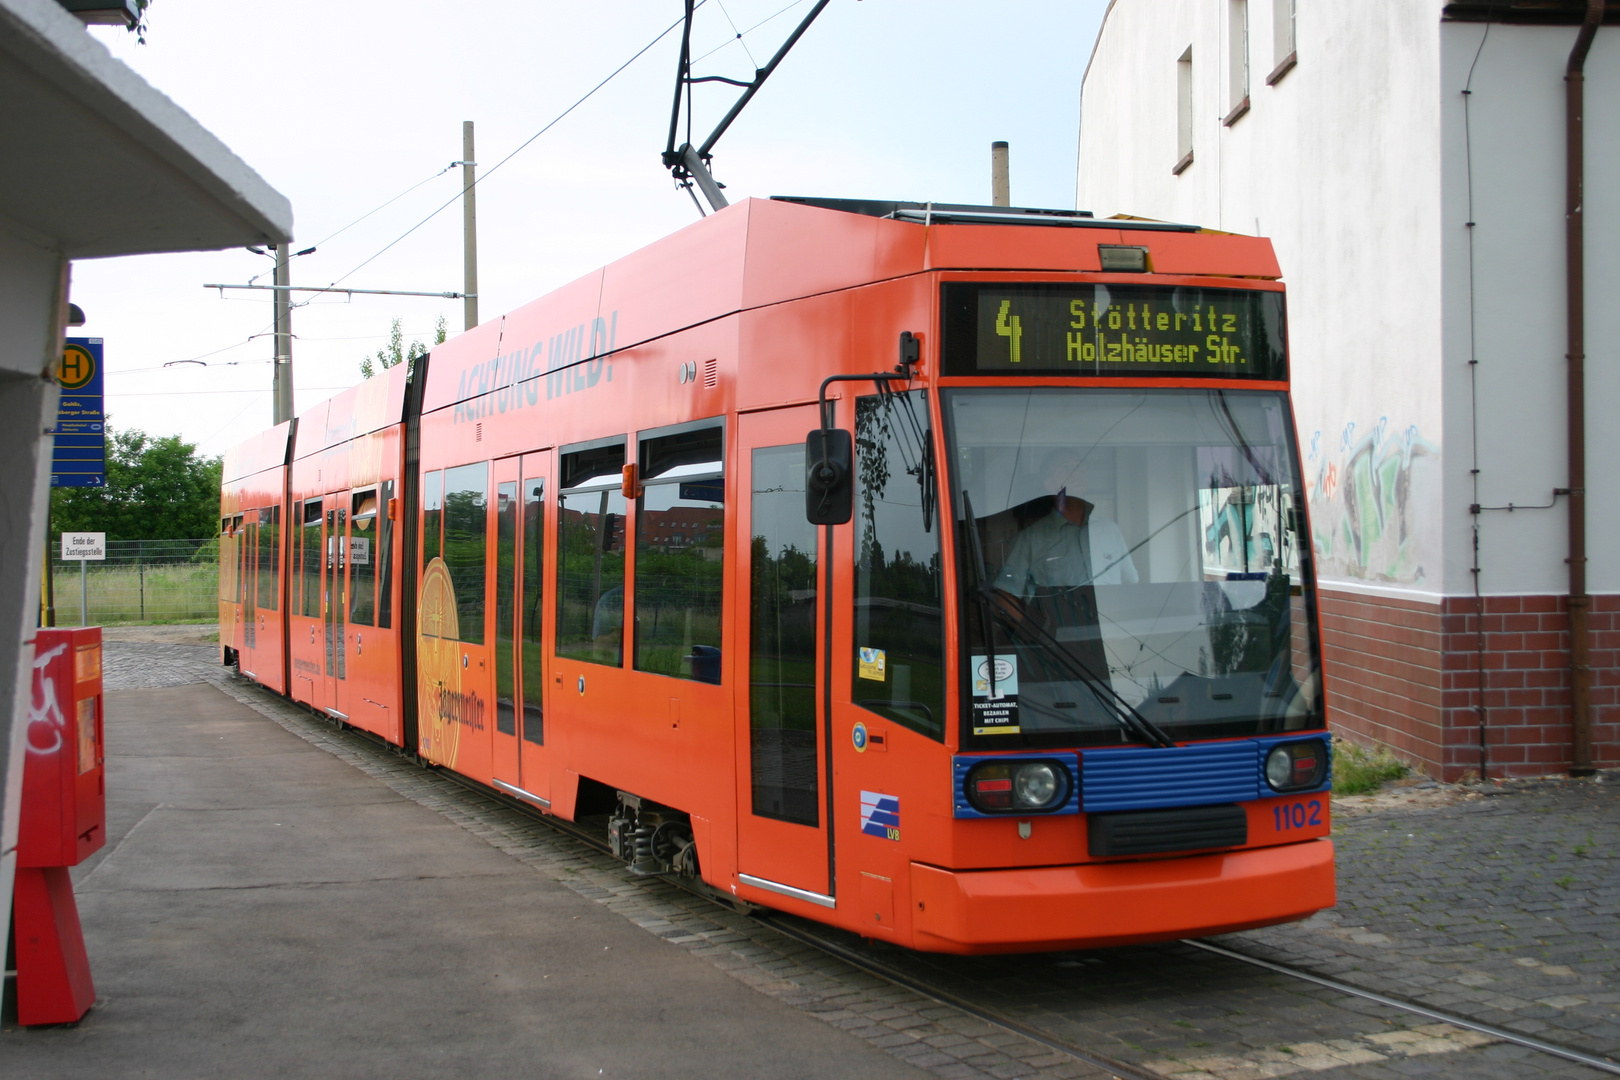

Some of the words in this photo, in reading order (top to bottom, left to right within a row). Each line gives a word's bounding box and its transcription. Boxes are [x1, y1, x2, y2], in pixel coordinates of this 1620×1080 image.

[995, 300, 1022, 362] 4
[1070, 299, 1237, 332] Stötteritz
[1066, 331, 1199, 364] Holzhäuser
[1206, 335, 1246, 364] Str.
[62, 354, 80, 379] H
[453, 341, 543, 425] ACHTUNG
[546, 310, 618, 401] WILD!
[66, 548, 103, 557] Zustiegsstelle
[73, 537, 85, 545] Ende
[87, 537, 95, 545] der
[1273, 800, 1322, 831] 1102
[887, 828, 899, 841] LVB
